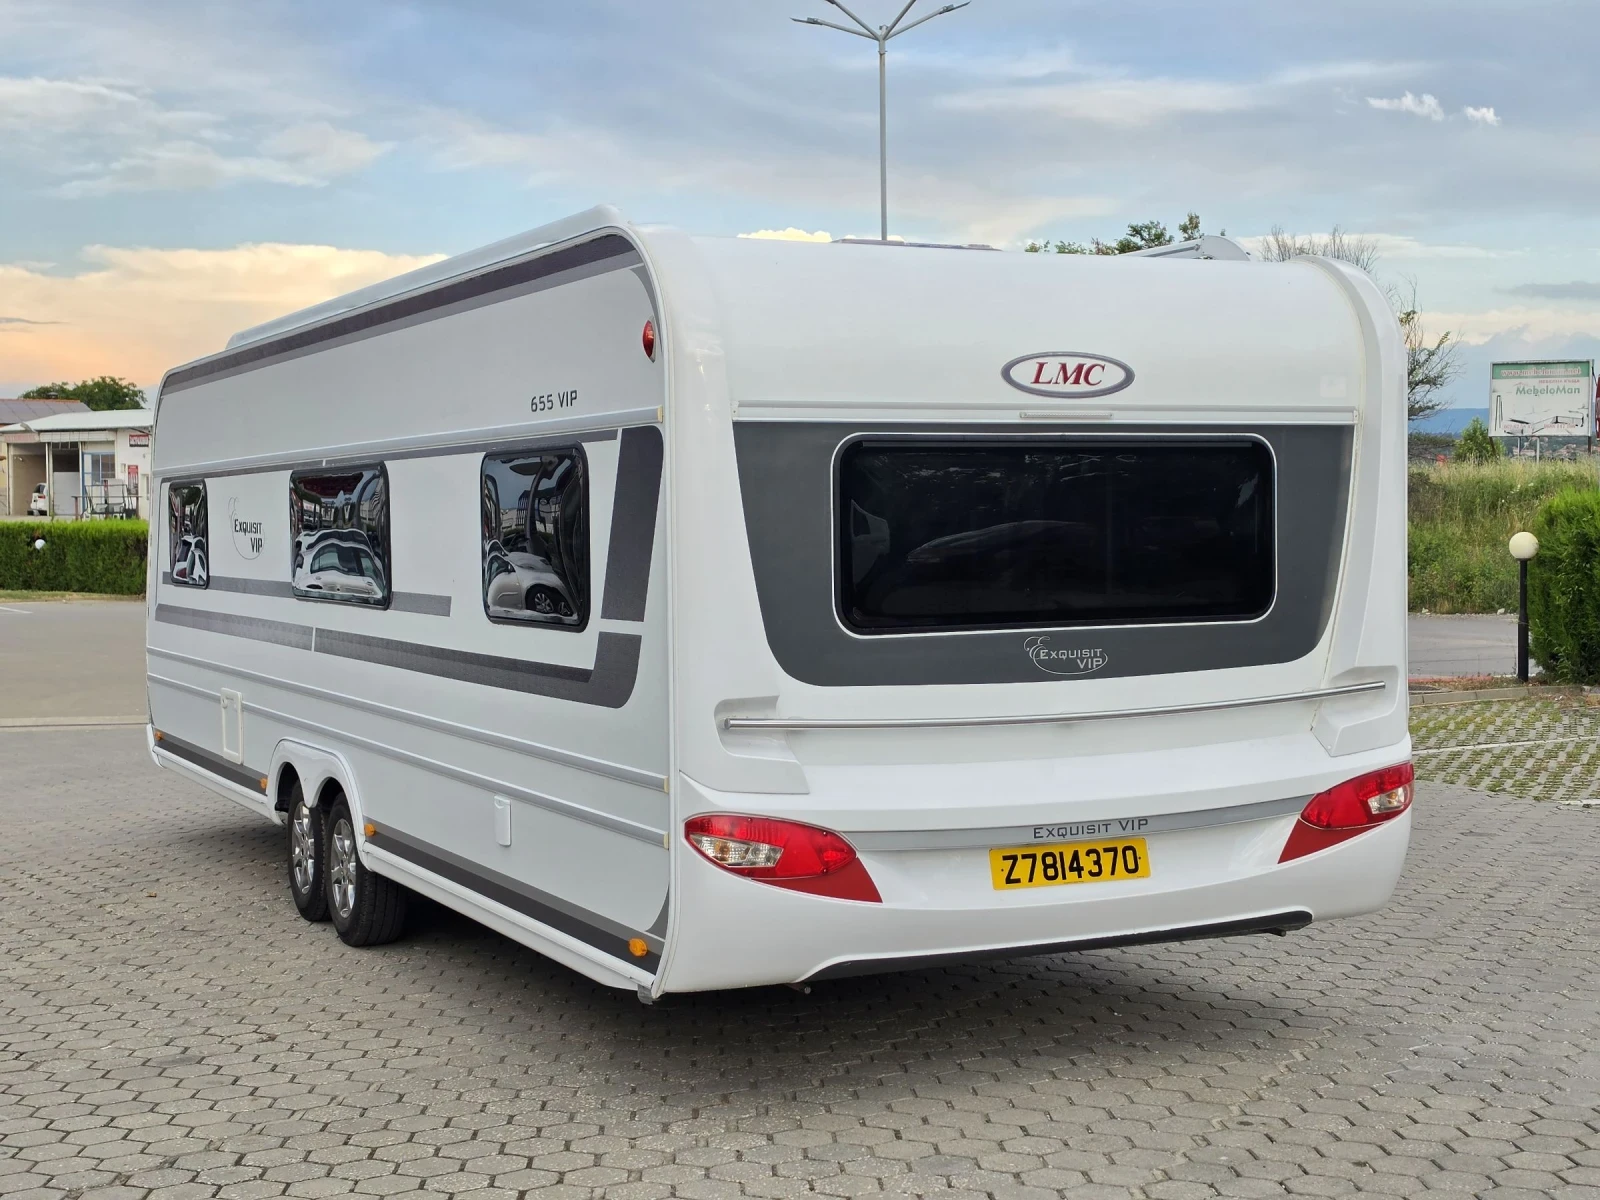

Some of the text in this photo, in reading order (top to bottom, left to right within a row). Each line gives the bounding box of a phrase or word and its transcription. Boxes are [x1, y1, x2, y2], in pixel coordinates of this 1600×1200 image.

[1030, 361, 1105, 386] LMC
[1516, 385, 1580, 395] MebeloMan
[531, 390, 577, 412] 655 VIP
[234, 519, 262, 536] EXQUISIT
[250, 537, 263, 553] VIP
[1040, 649, 1102, 660] EXQUISIT
[1077, 658, 1103, 669] VIP
[1033, 818, 1149, 839] EXQUISIT VIP
[1002, 845, 1139, 885] Z7814370
